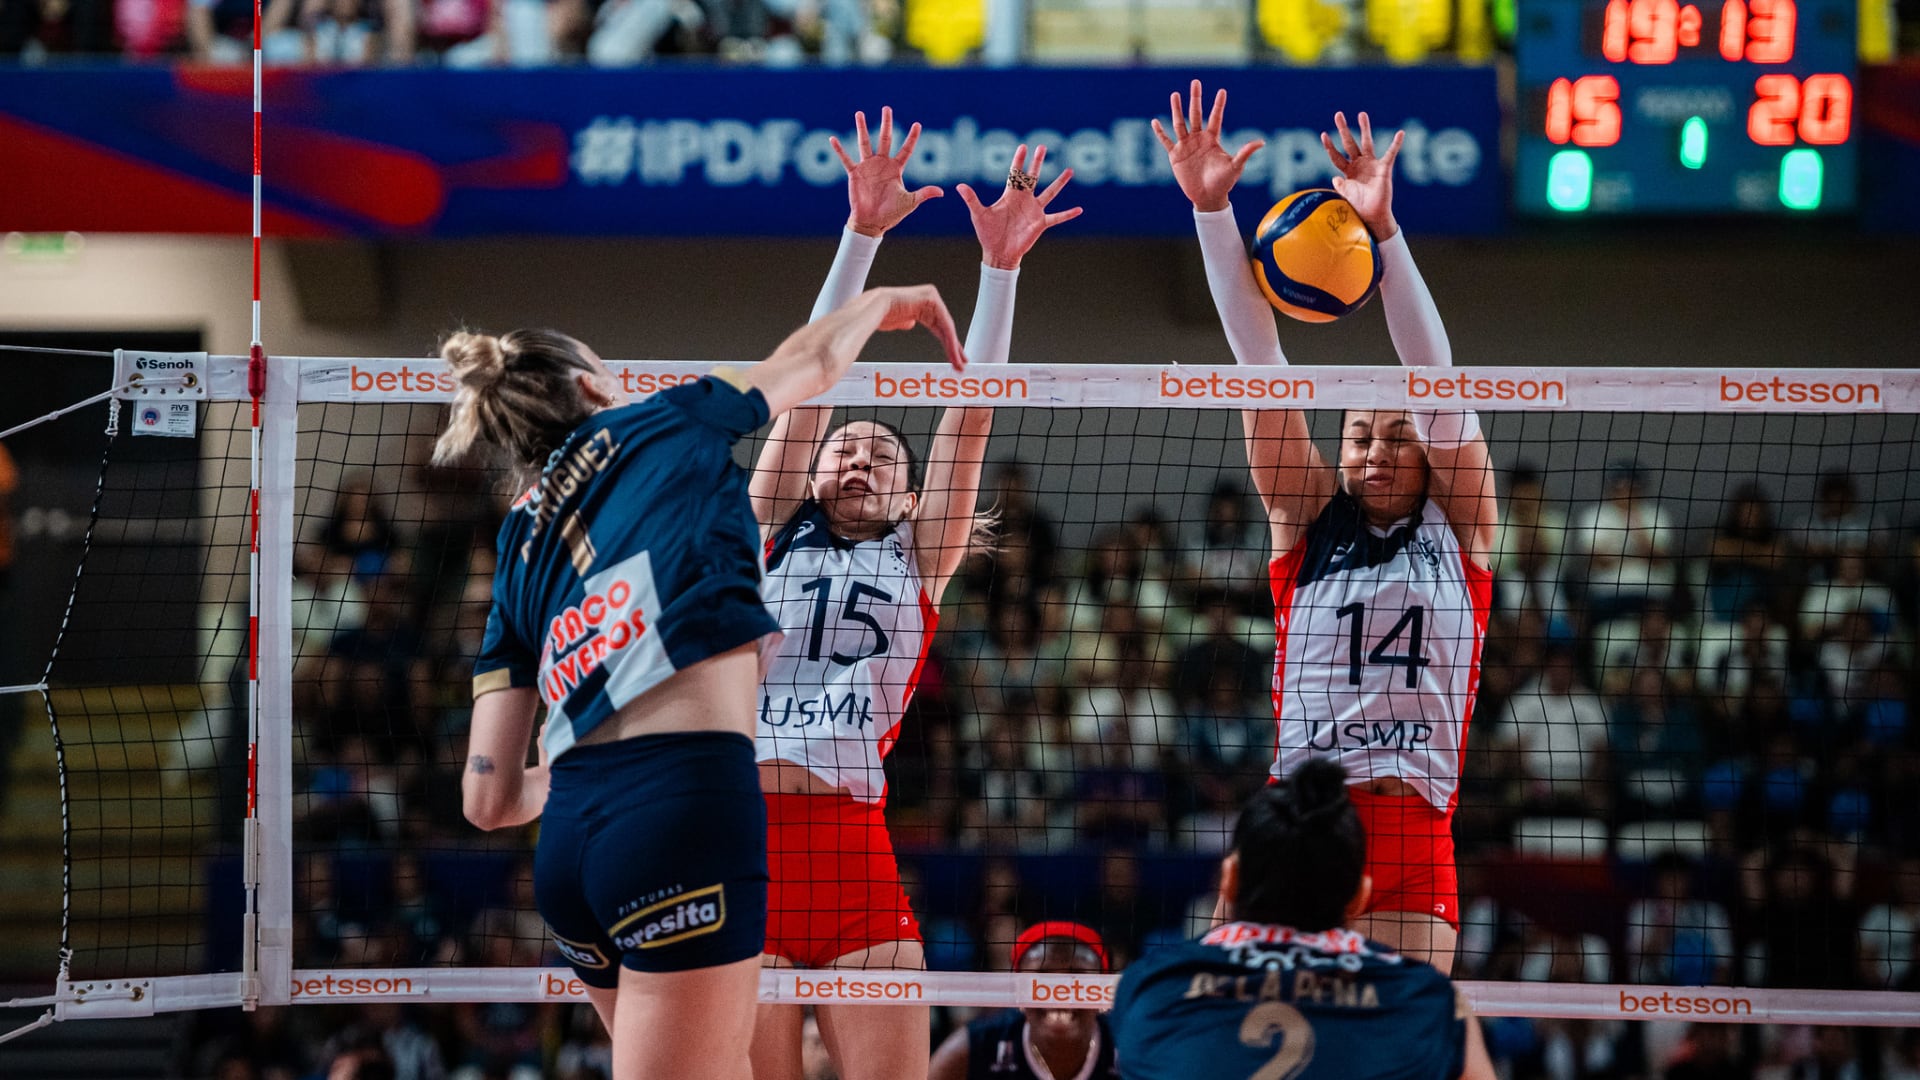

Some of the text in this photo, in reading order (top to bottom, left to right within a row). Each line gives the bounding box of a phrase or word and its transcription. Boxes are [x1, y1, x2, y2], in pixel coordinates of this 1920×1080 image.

[1546, 75, 1622, 147] 15
[1747, 73, 1853, 146] 20
[148, 359, 194, 370] Senoh
[875, 371, 1027, 398] betsson
[1161, 372, 1314, 399] betsson
[1408, 372, 1563, 400] betsson
[1720, 375, 1880, 404] betsson
[550, 577, 632, 652] SACO
[801, 577, 893, 667] 15
[1336, 602, 1431, 689] 14
[545, 607, 647, 703] LIVEROS
[1309, 719, 1433, 753] USMP
[618, 883, 682, 917] PINTURAS
[795, 976, 922, 998] betsson
[1619, 991, 1752, 1014] betsson
[1238, 1001, 1316, 1080] 2
